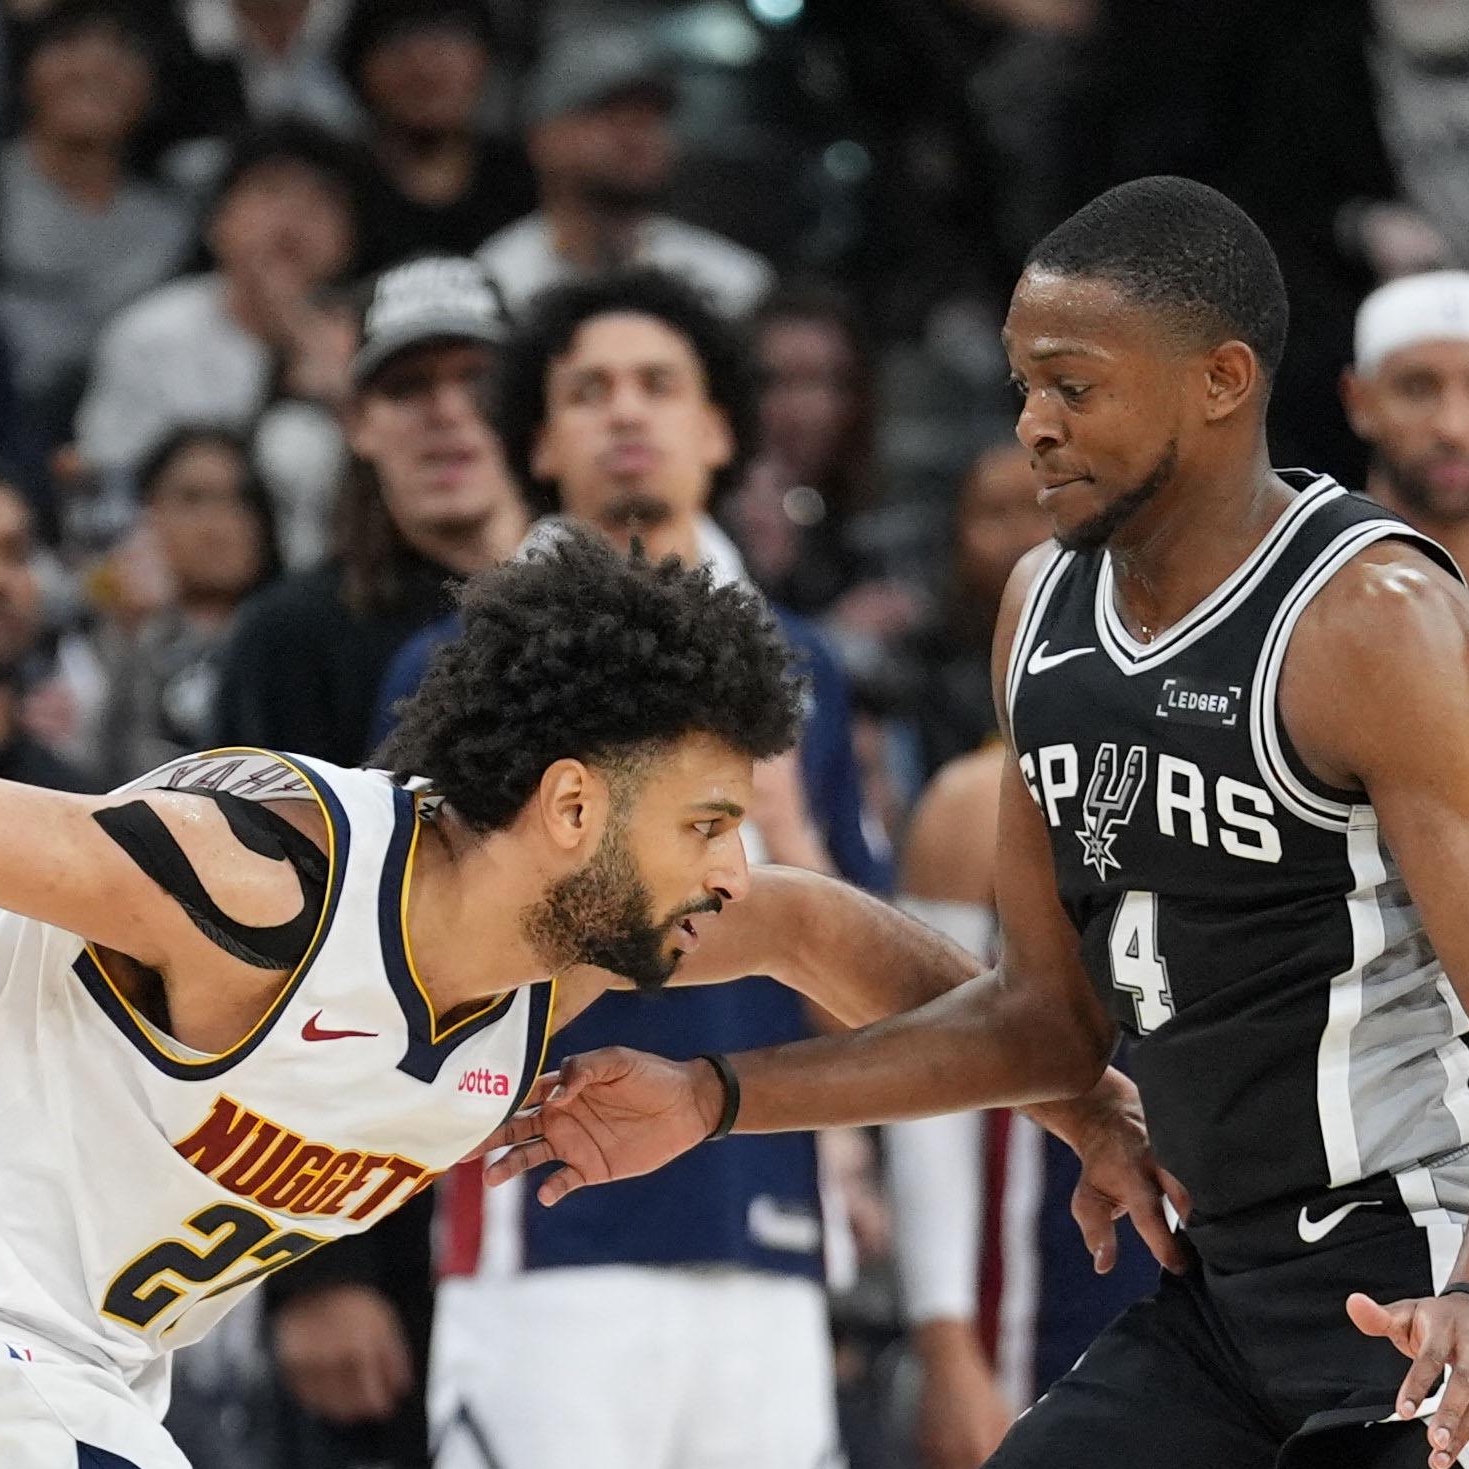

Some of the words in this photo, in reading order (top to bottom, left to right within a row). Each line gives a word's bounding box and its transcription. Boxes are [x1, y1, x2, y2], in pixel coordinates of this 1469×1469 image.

[1168, 690, 1229, 714] LEDGER
[1108, 890, 1177, 1036] 4
[172, 1092, 449, 1223] NUGGET
